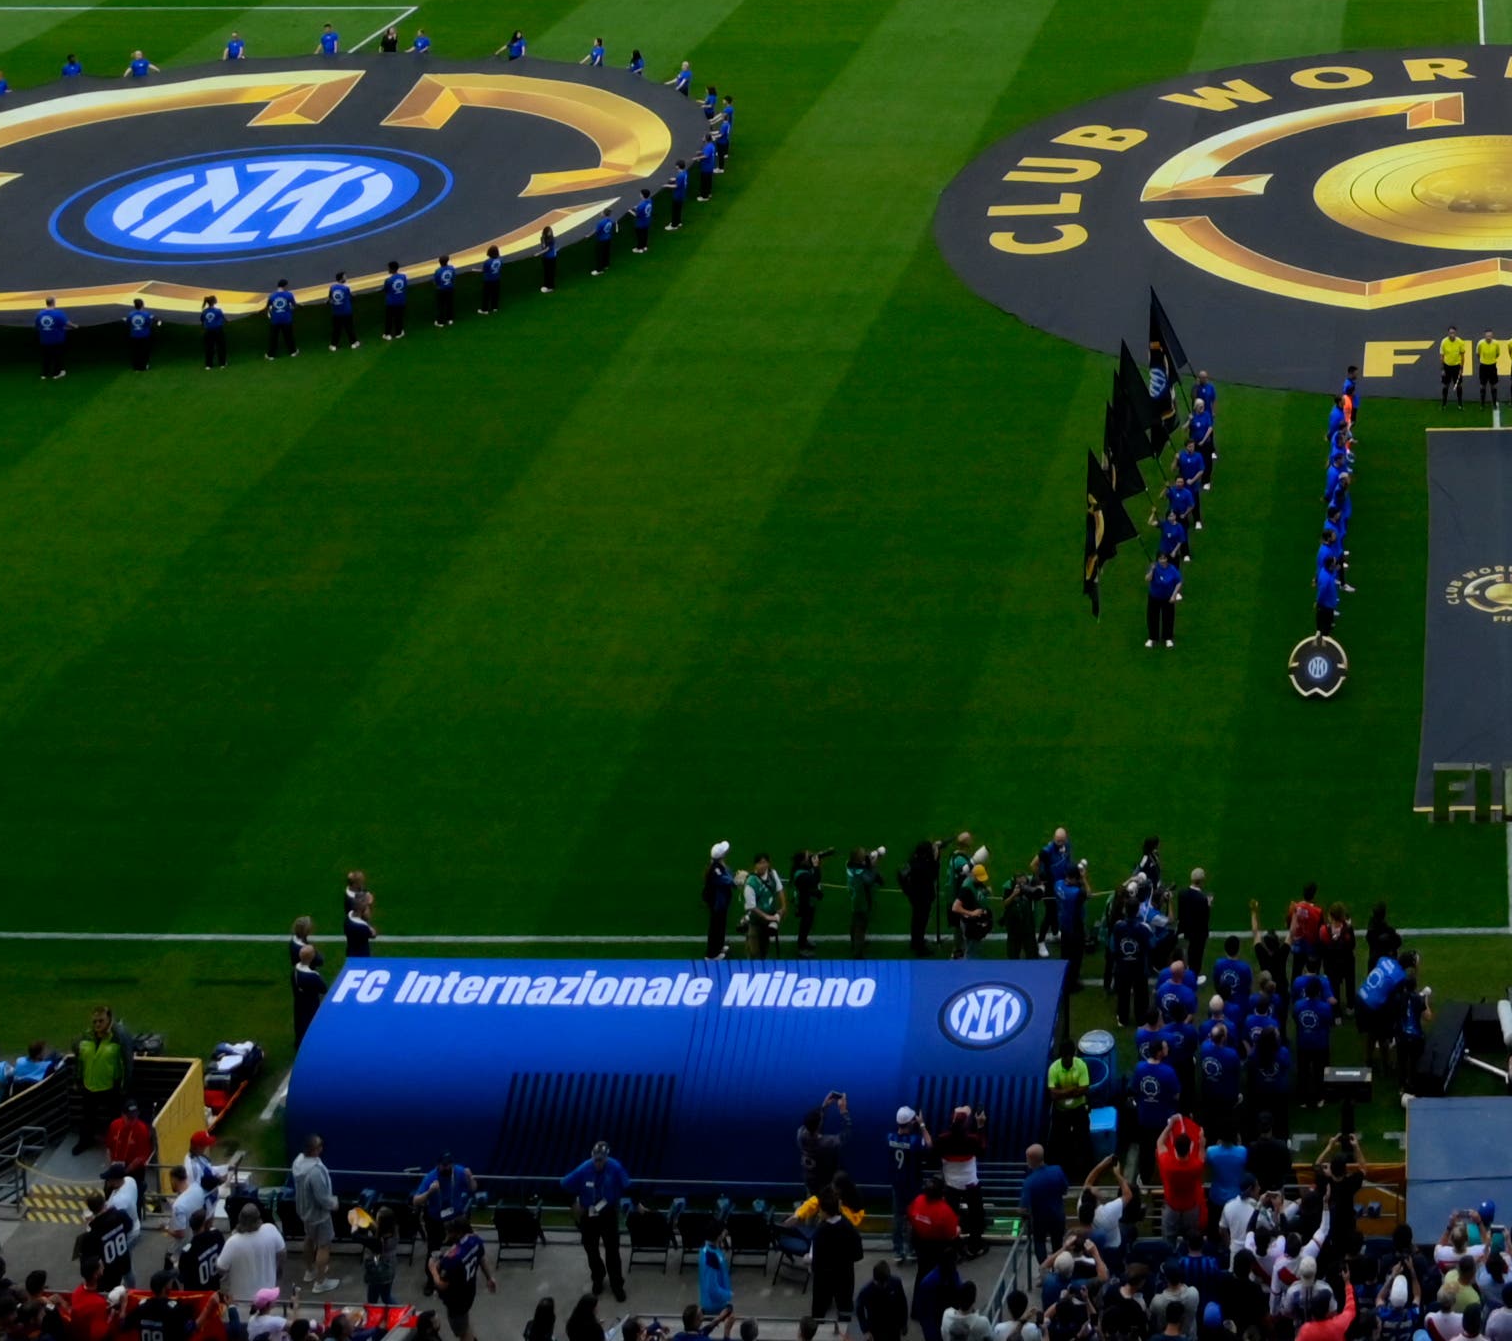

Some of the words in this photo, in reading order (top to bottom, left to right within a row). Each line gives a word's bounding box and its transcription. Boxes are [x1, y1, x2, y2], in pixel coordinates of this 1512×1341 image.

[987, 123, 1149, 256] CLUB
[1445, 575, 1465, 608] CLUB
[331, 967, 389, 1006] FC
[392, 967, 714, 1009] Internazionale
[721, 970, 878, 1010] Milano
[894, 1147, 904, 1169] 9
[103, 1233, 129, 1264] 08
